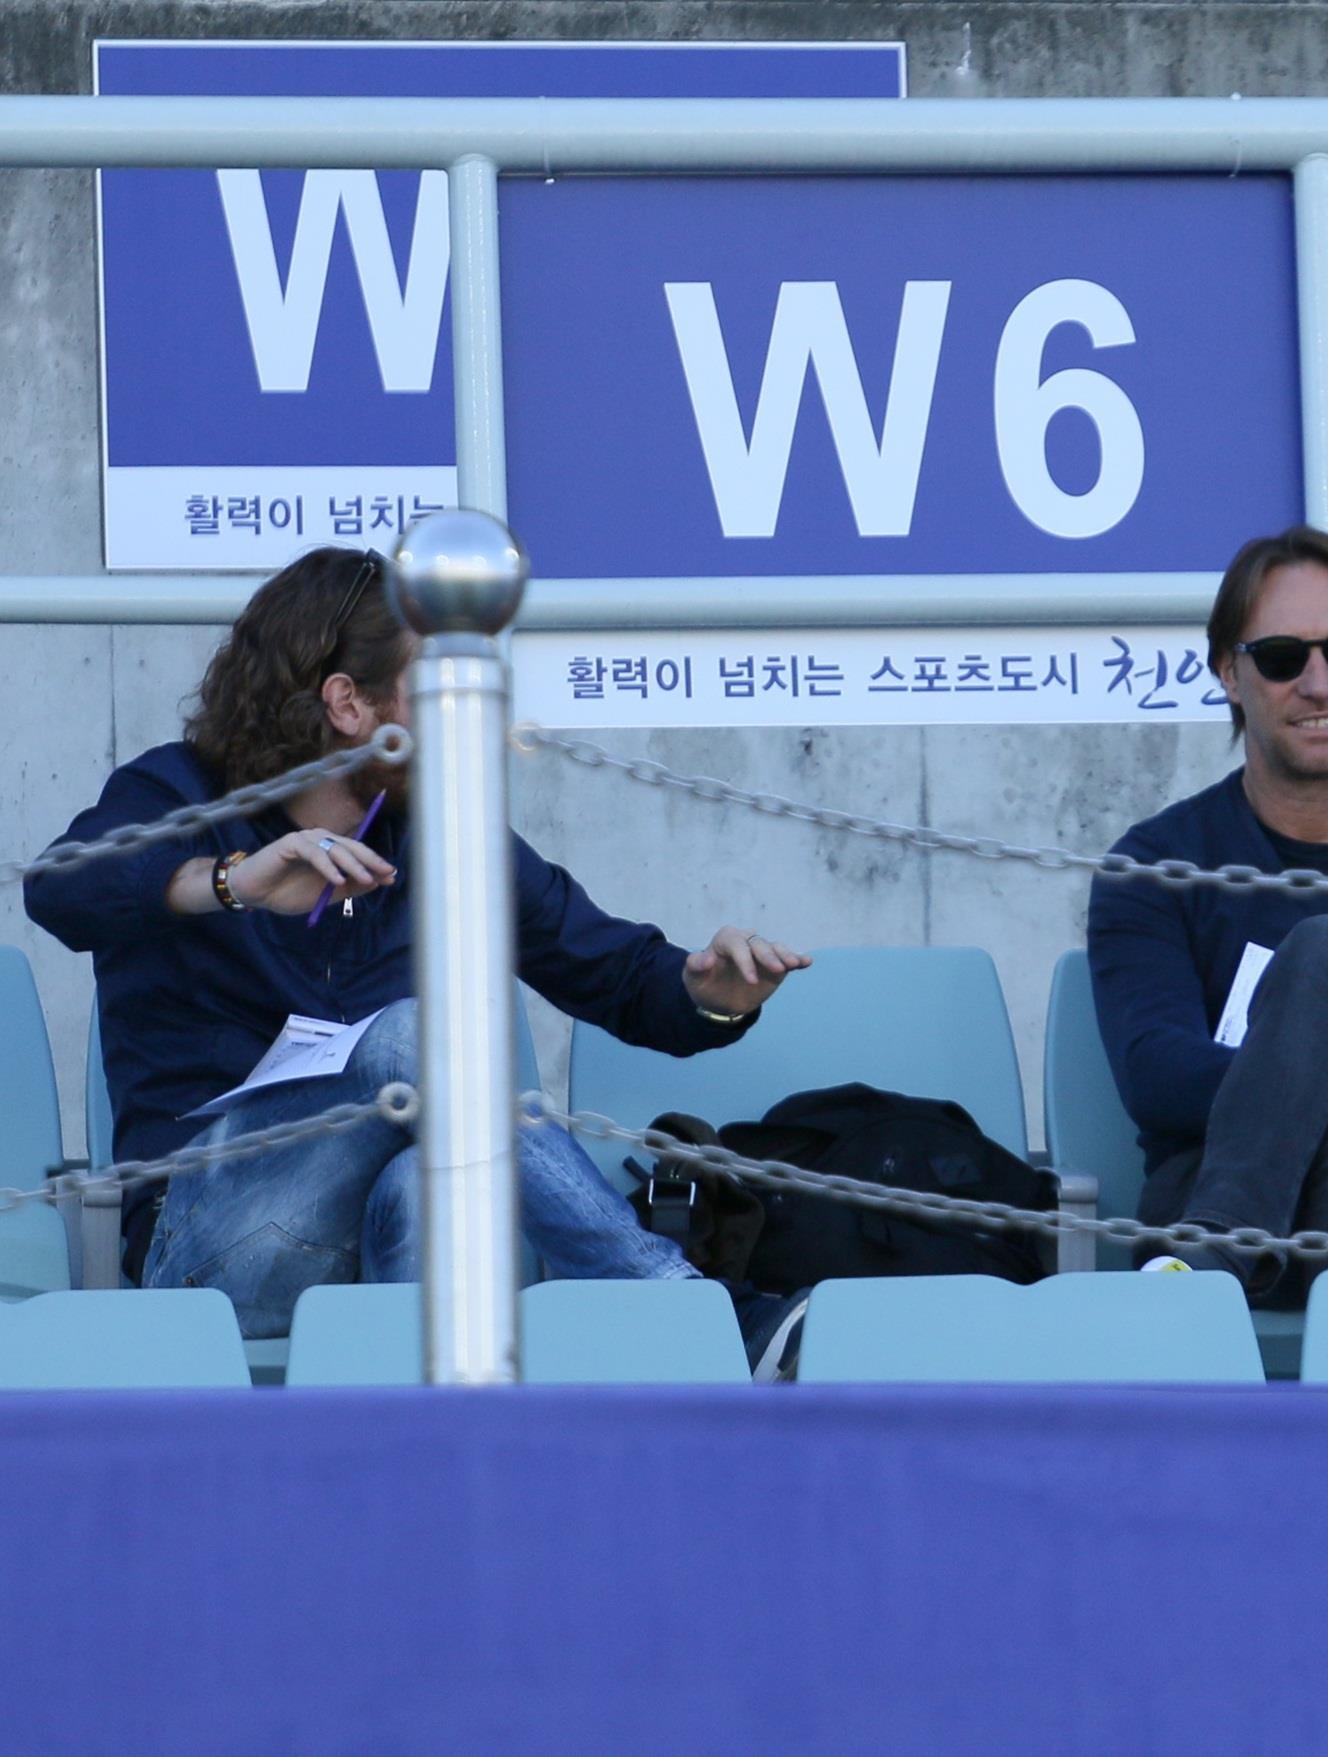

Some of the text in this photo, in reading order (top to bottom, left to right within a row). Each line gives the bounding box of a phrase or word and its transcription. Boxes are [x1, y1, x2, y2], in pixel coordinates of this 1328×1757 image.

[216, 168, 449, 393] W
[185, 495, 304, 536] 활력이
[567, 656, 693, 700] 활력이
[719, 655, 846, 698] 넘치는
[868, 654, 1080, 696] 스포츠도시
